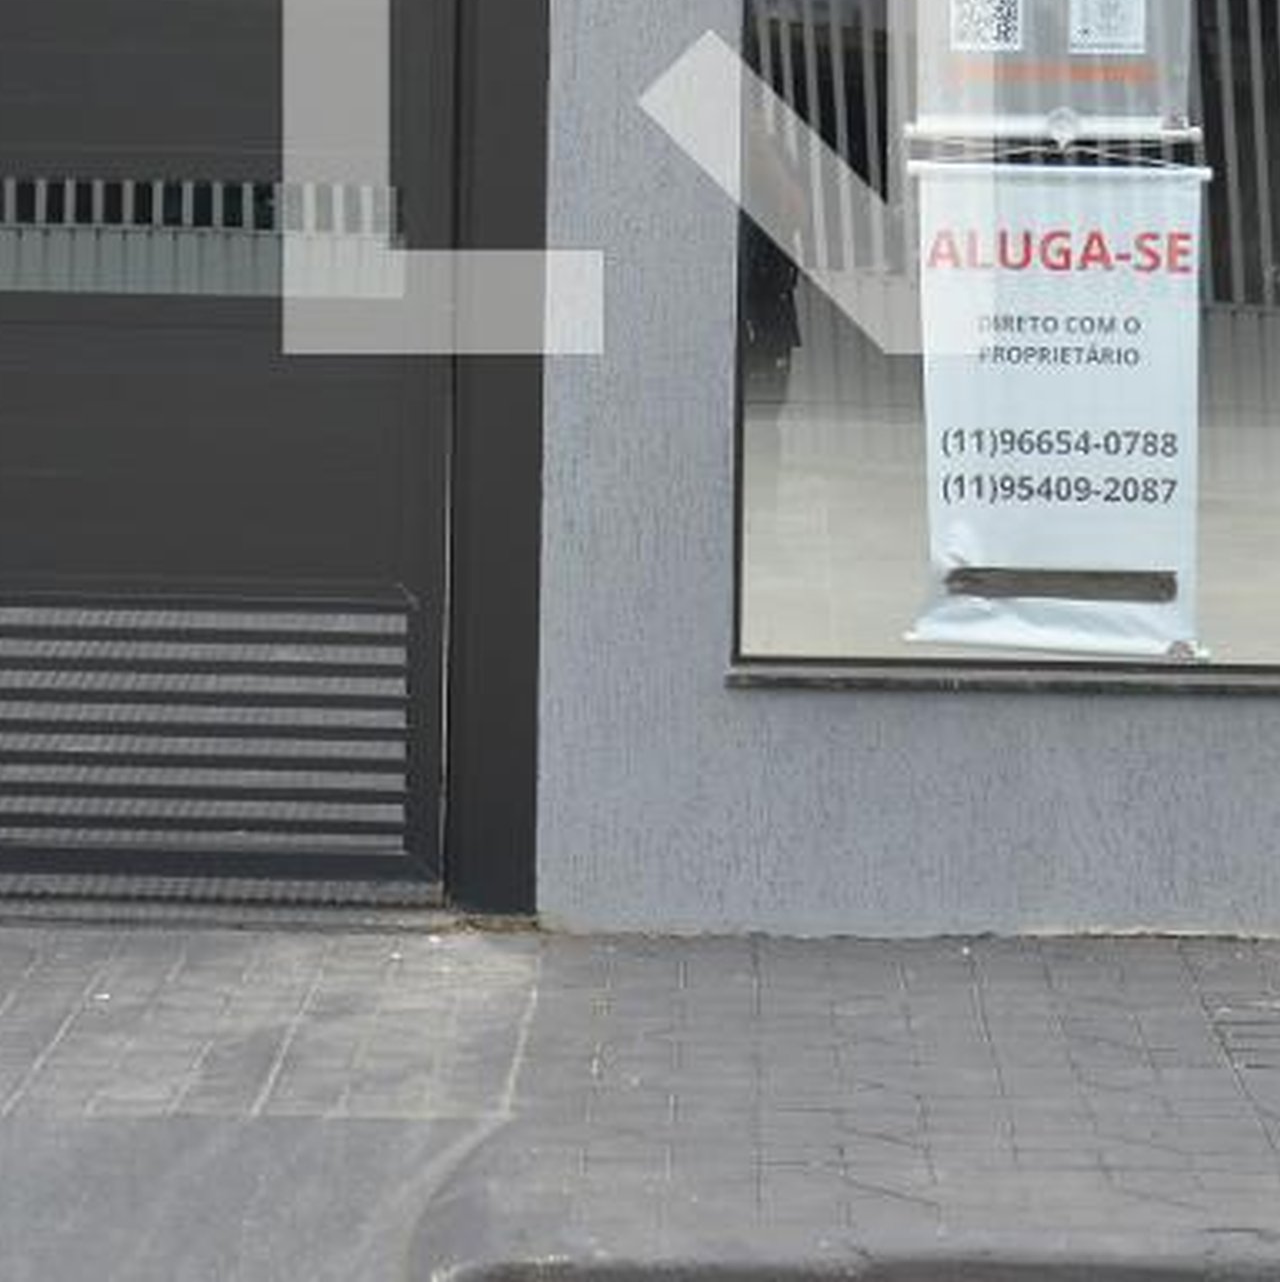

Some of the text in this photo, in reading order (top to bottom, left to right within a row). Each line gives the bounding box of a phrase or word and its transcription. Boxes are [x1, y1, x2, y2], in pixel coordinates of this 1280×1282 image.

[927, 229, 1193, 274] ALUGA-SE
[978, 315, 1142, 335] DIRETO COM O
[941, 427, 1179, 460] (11)96654-0788
[942, 474, 1179, 507] (11)95409-2087
